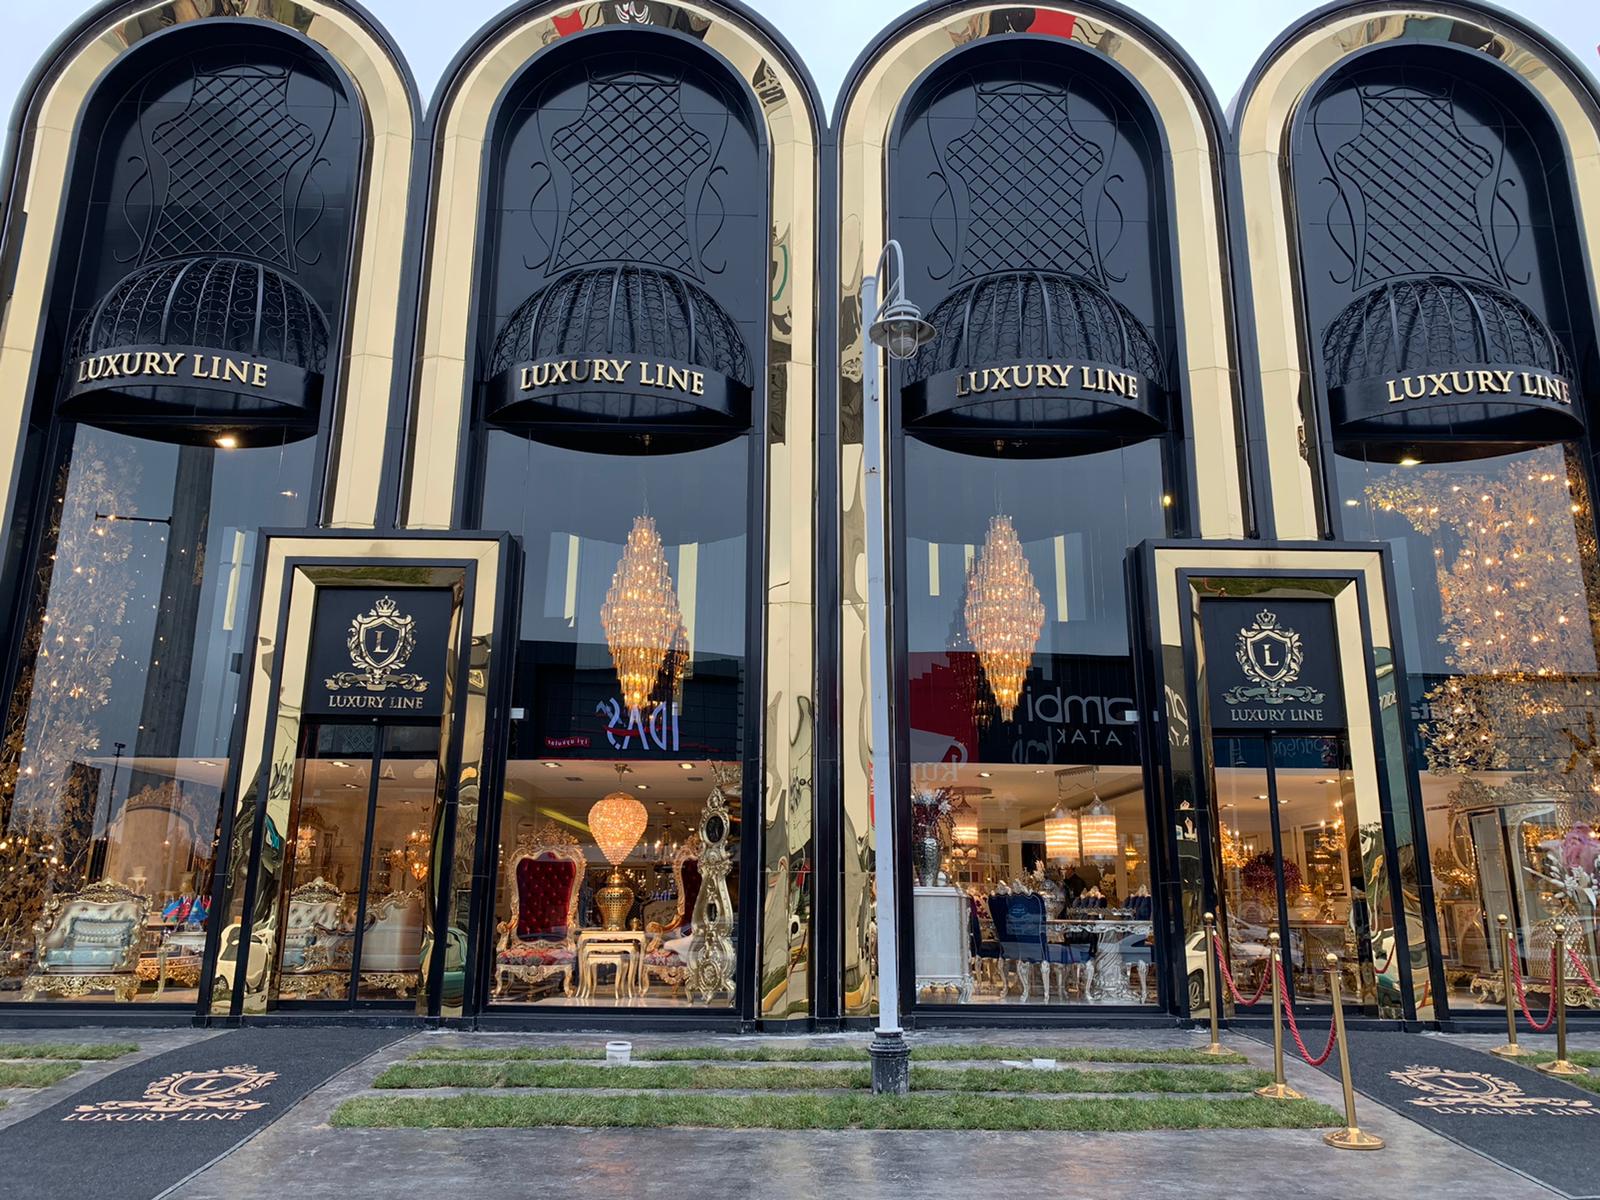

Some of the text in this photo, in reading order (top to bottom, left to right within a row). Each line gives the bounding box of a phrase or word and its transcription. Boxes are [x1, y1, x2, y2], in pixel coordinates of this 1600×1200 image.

[78, 352, 269, 387] LUXURY LINE
[520, 359, 705, 396] LUXURY LINE
[956, 364, 1139, 399] LUXURY LINE
[1385, 370, 1572, 404] LUXURY LINE
[373, 631, 389, 652] L
[1262, 644, 1279, 667] L
[328, 695, 424, 710] LUXURY LINE
[1230, 709, 1324, 722] LUXURY LINE
[192, 1078, 221, 1091] L
[61, 1111, 248, 1122] LUXURY LINE
